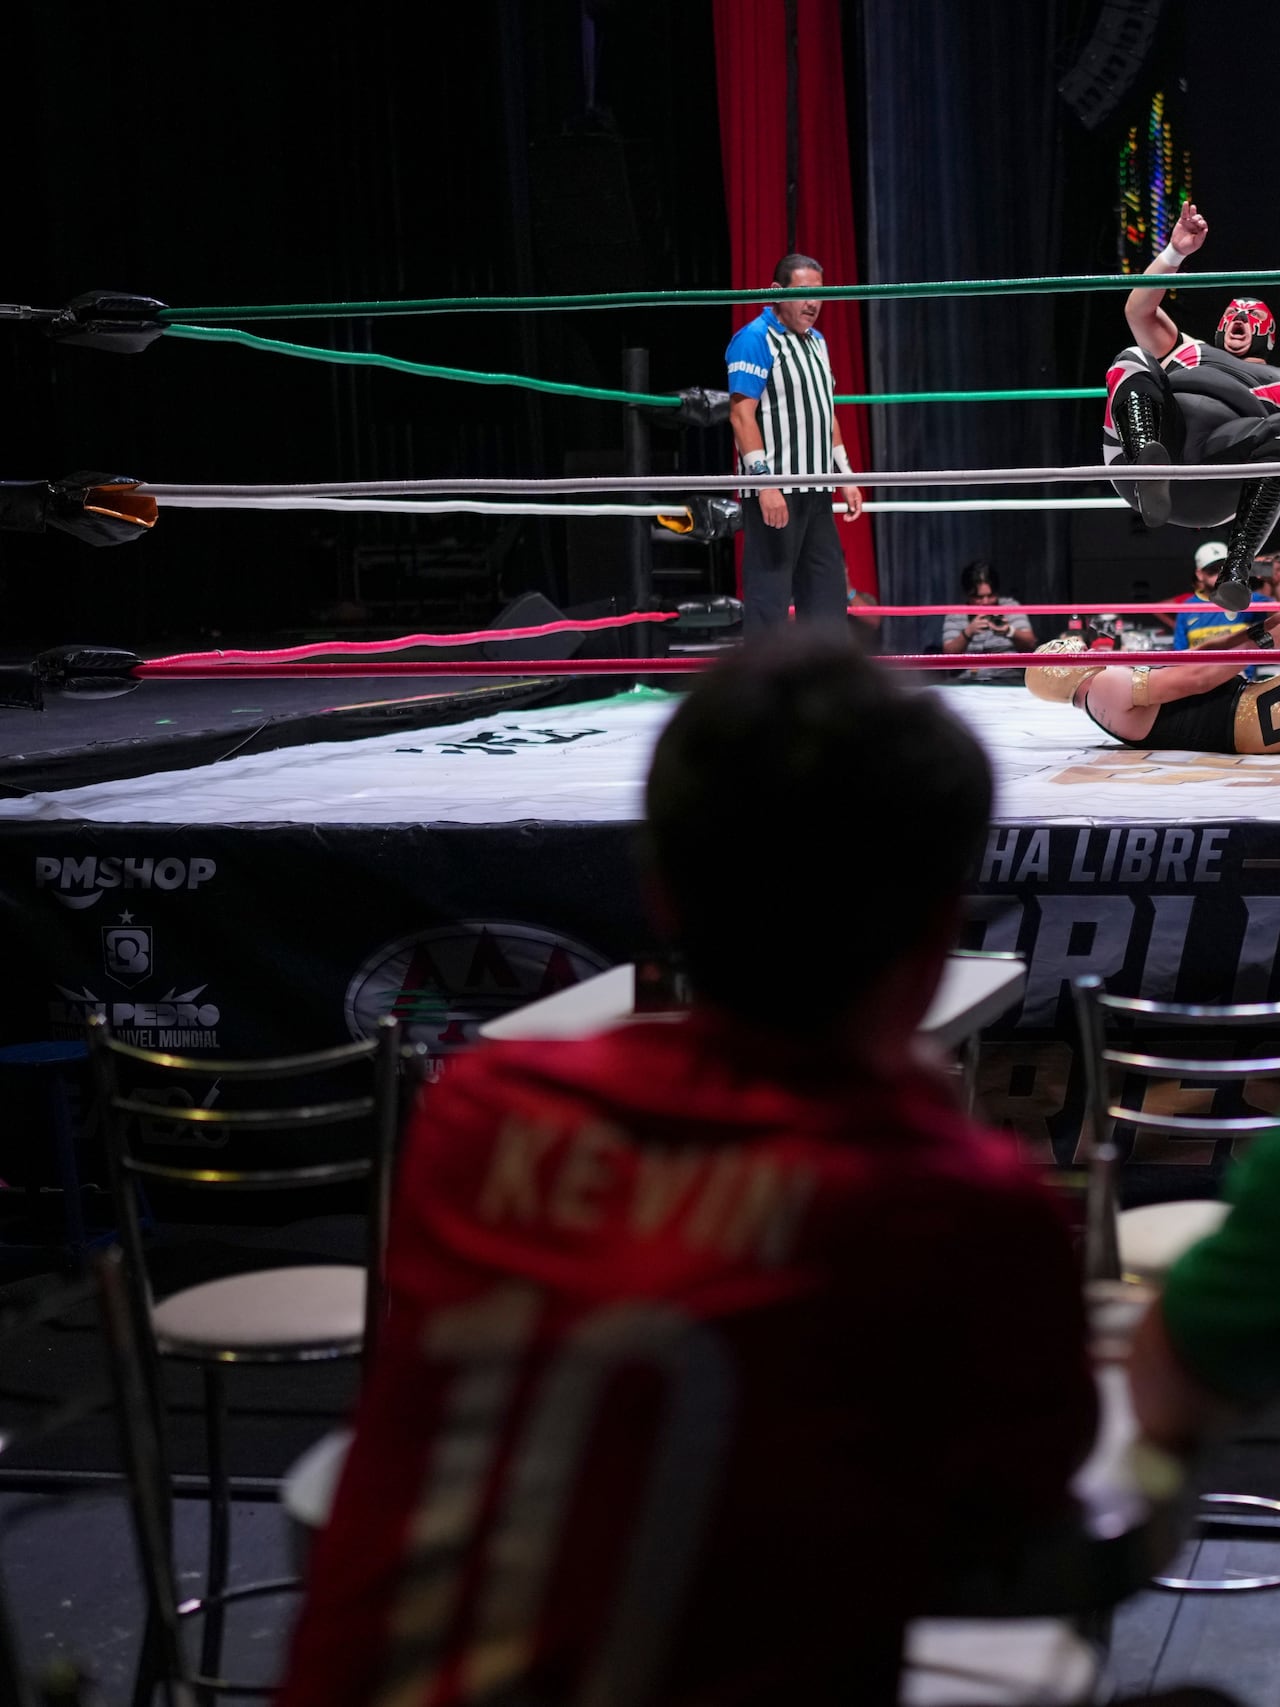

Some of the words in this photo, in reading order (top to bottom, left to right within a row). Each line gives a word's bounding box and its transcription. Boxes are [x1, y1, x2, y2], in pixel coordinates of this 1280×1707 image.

[35, 856, 217, 890] PMSHOP
[1069, 828, 1231, 882] LIBRE
[112, 1002, 221, 1027] PEDRO
[159, 1030, 221, 1049] MUNDIAL
[475, 1108, 822, 1272] KEVIN
[365, 1277, 738, 1706] 10
